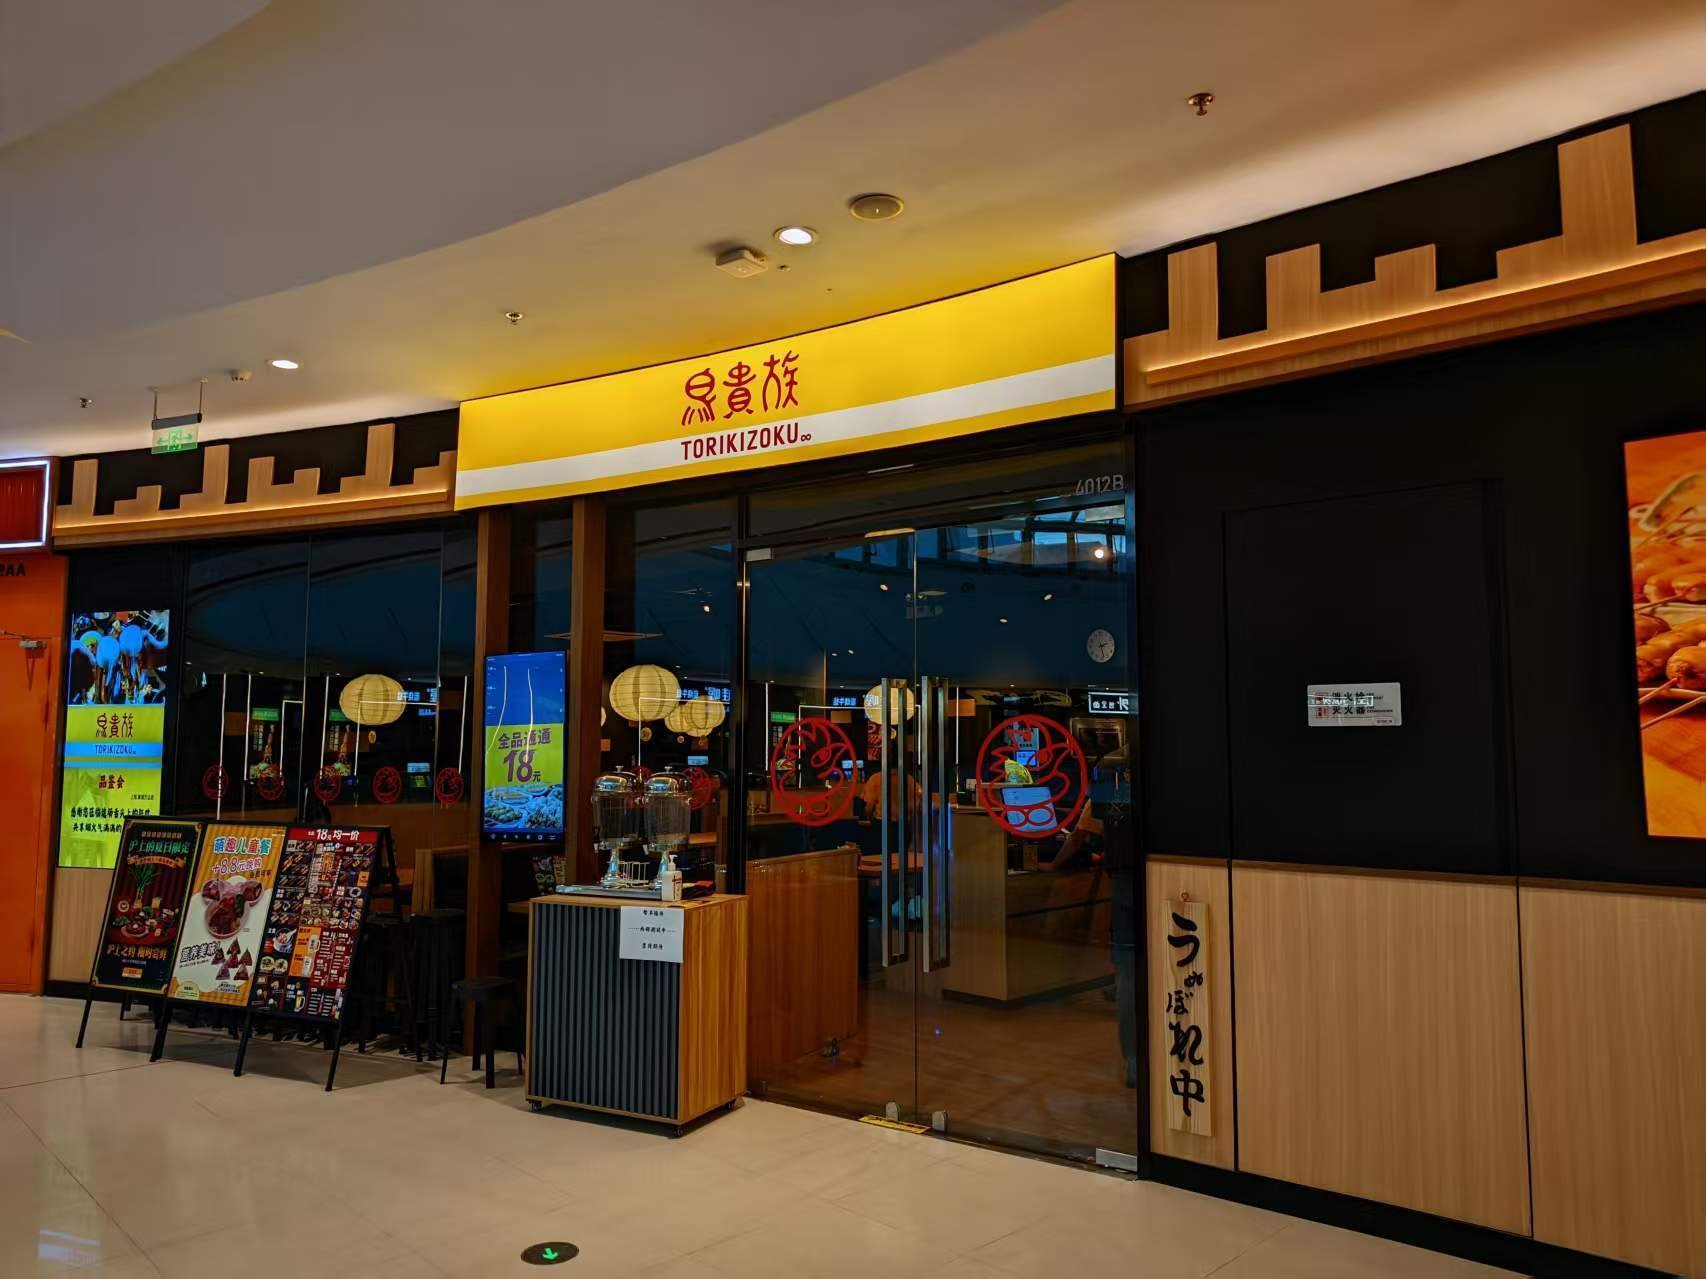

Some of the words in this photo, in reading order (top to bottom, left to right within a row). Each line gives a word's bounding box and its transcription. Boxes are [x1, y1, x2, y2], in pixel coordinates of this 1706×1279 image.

[681, 422, 799, 460] TORIKIZOKU
[1075, 474, 1124, 496] 4012B
[498, 728, 551, 750] 全品通通
